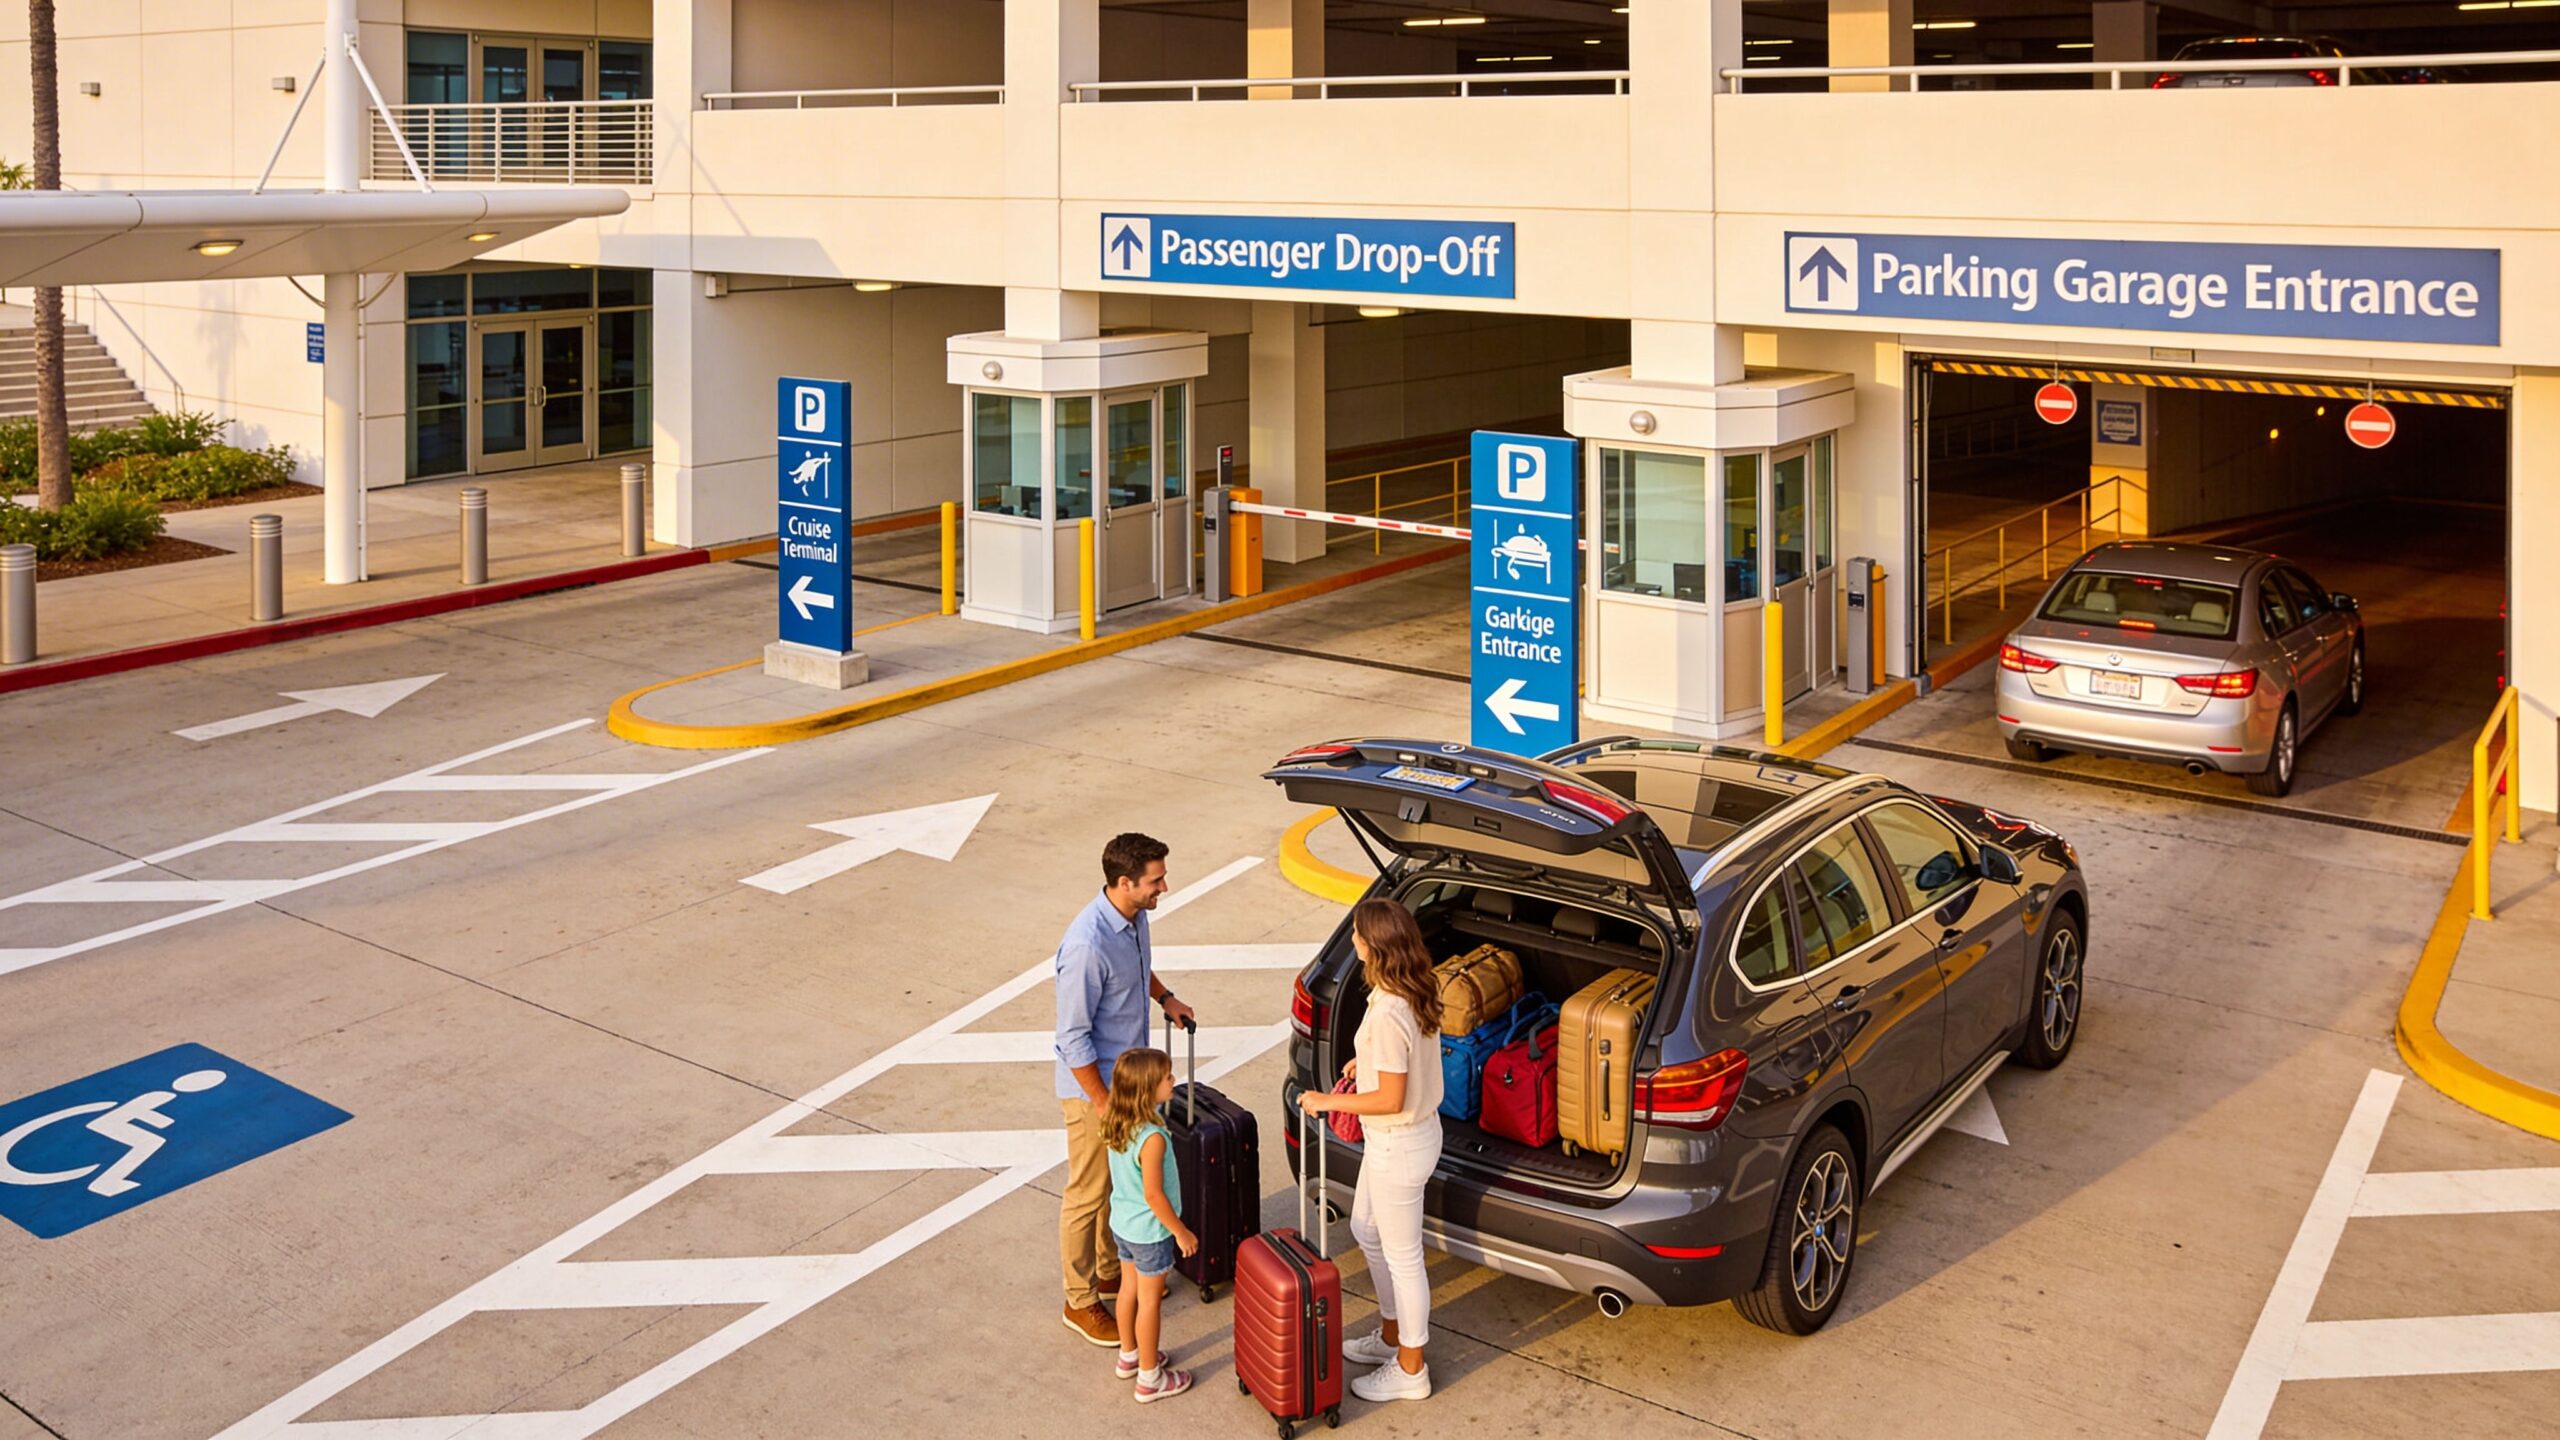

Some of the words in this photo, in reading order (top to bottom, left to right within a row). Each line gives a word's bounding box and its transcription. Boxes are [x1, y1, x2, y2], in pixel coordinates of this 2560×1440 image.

[1161, 229, 1326, 278] Passenger
[1336, 233, 1502, 284] Drop-Off
[1872, 252, 2038, 312] Parking
[2053, 259, 2229, 318] Garage
[2245, 264, 2479, 317] Entrance
[801, 392, 820, 427] P
[1508, 450, 1538, 494] P
[788, 515, 832, 540] Cruise
[781, 537, 838, 564] Terminal
[1480, 632, 1562, 664] Entrance
